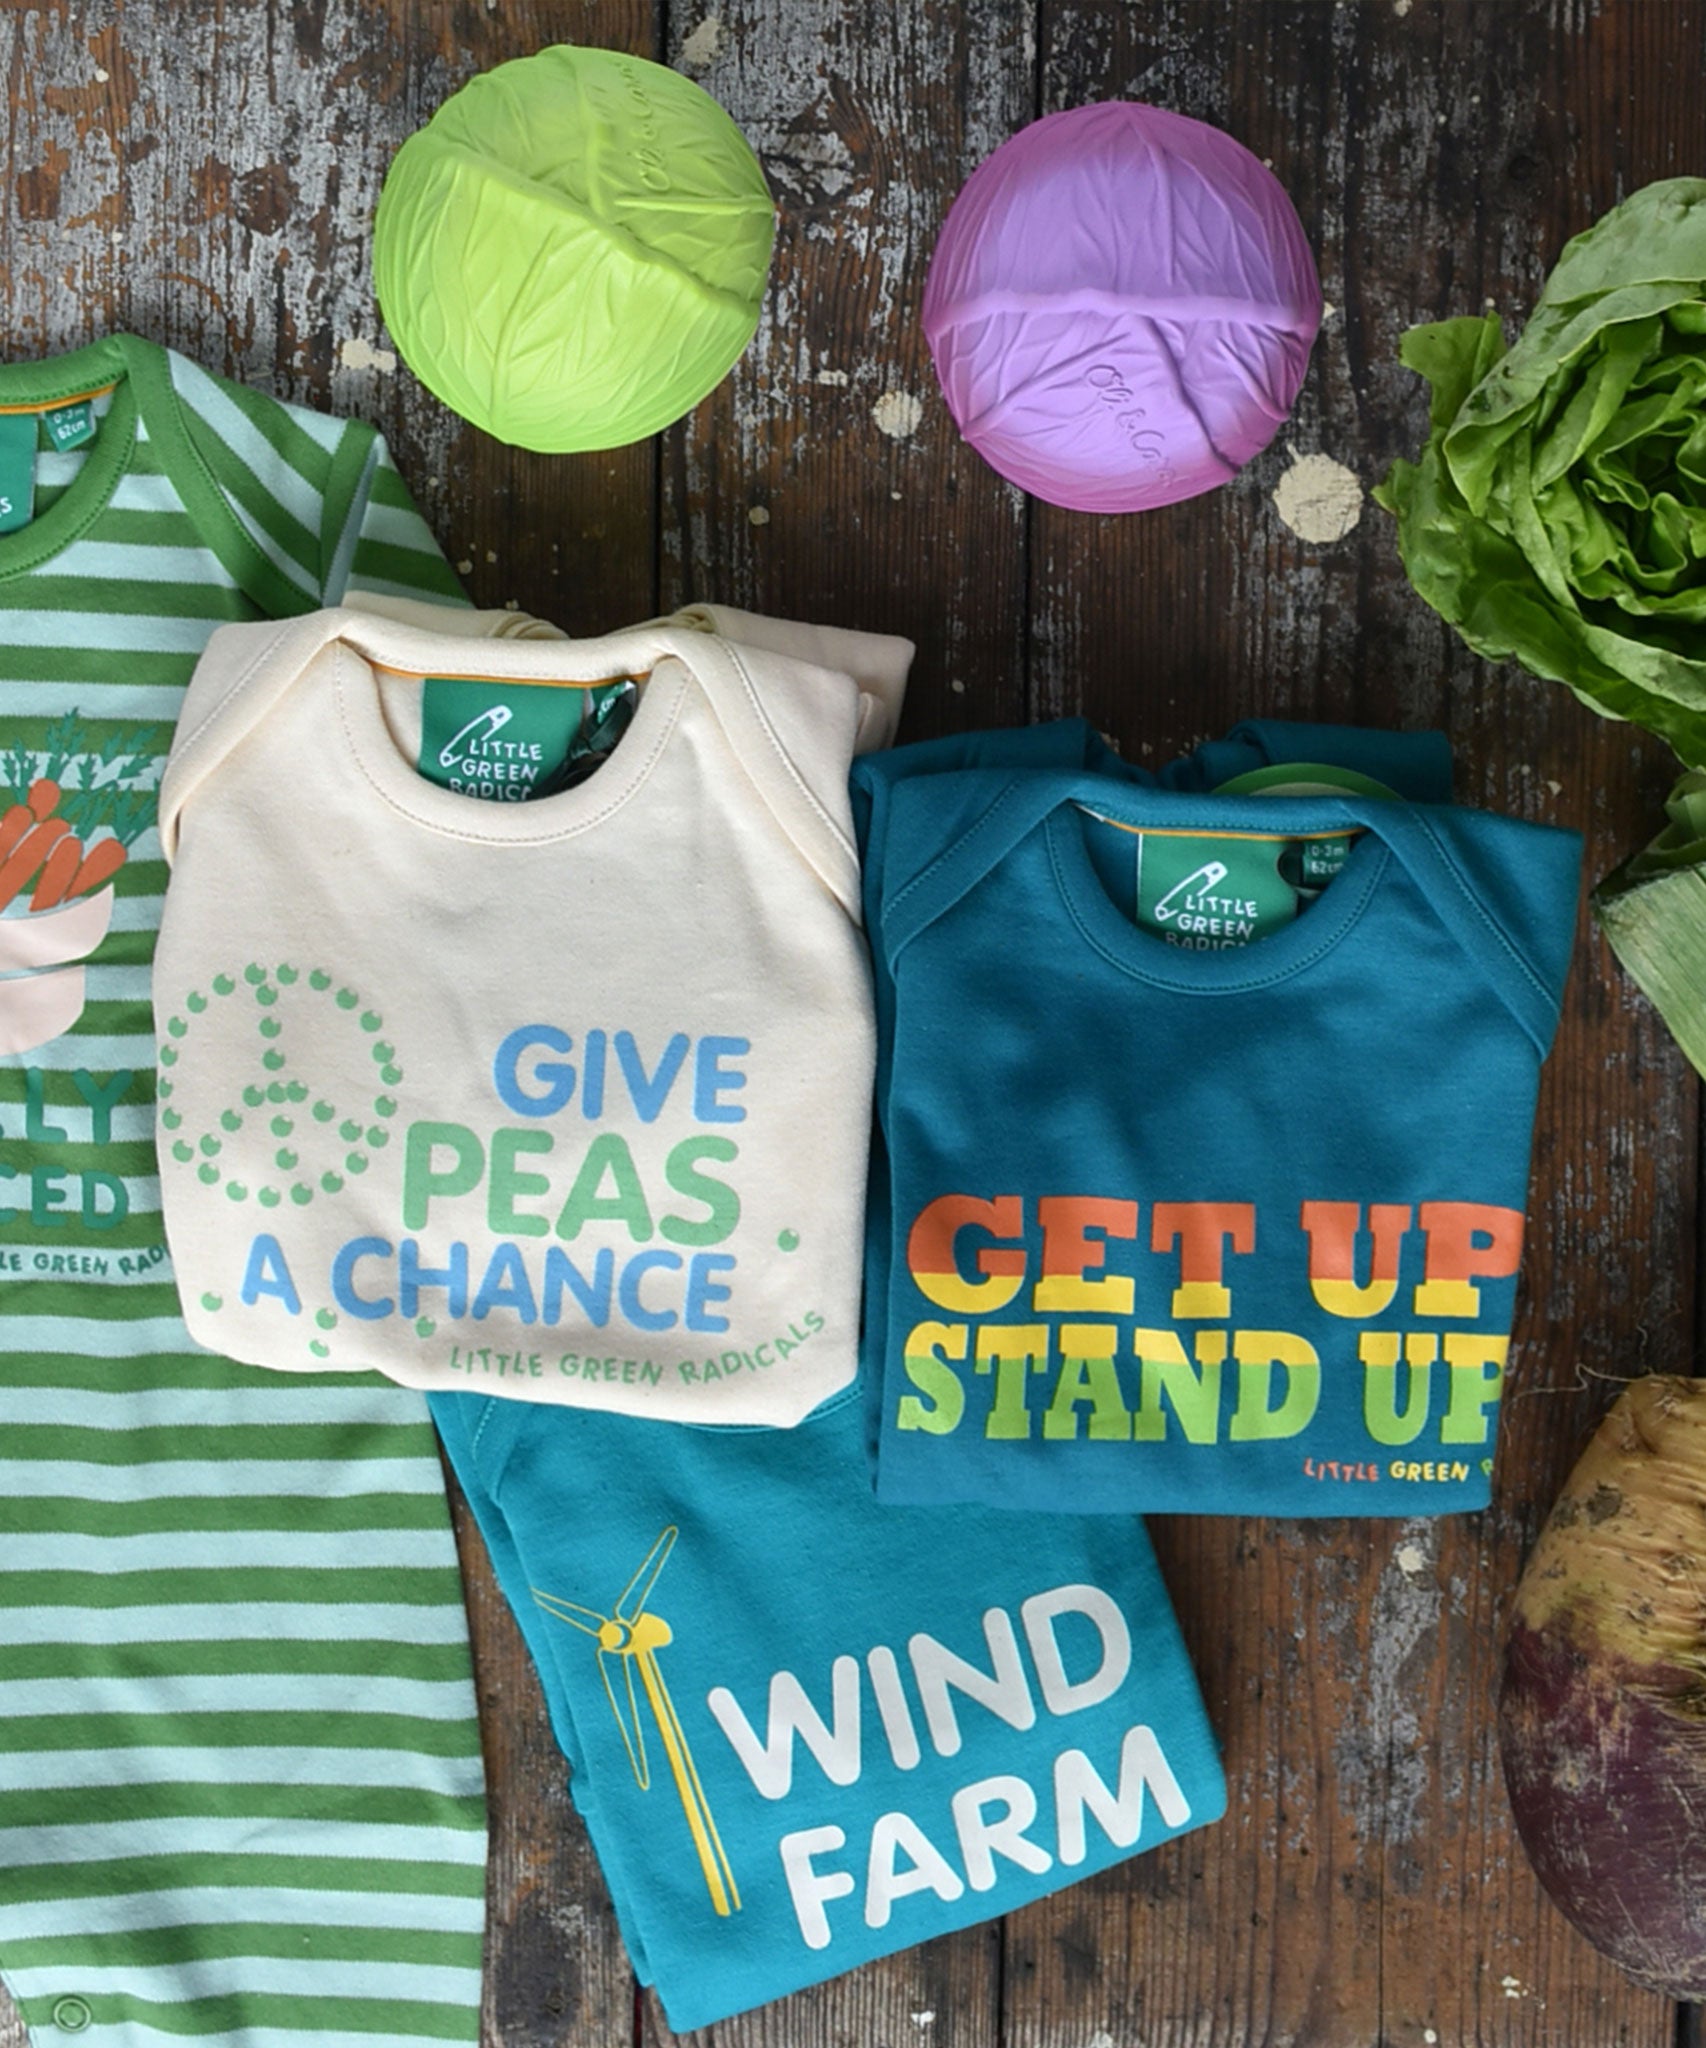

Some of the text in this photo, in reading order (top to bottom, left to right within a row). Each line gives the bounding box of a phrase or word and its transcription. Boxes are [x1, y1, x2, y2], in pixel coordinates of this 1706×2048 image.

[461, 758, 540, 784] GREEN
[469, 738, 543, 761] LITTLE
[1177, 912, 1255, 940] GREEN
[1186, 893, 1259, 918] LITTLE
[493, 1024, 752, 1124] GIVE
[402, 1121, 740, 1247] PEAS
[33, 1252, 109, 1277] GREEN
[240, 1234, 737, 1333] A CHANCE
[906, 1194, 1528, 1319] GET UP
[449, 1310, 827, 1387] LITTLE GREEN RADICALS
[896, 1321, 1512, 1446] STAND UP
[1303, 1457, 1379, 1482] LITTLE
[1389, 1459, 1470, 1483] GREEN
[707, 1584, 1132, 1800] WIND
[779, 1725, 1192, 1951] FARM
